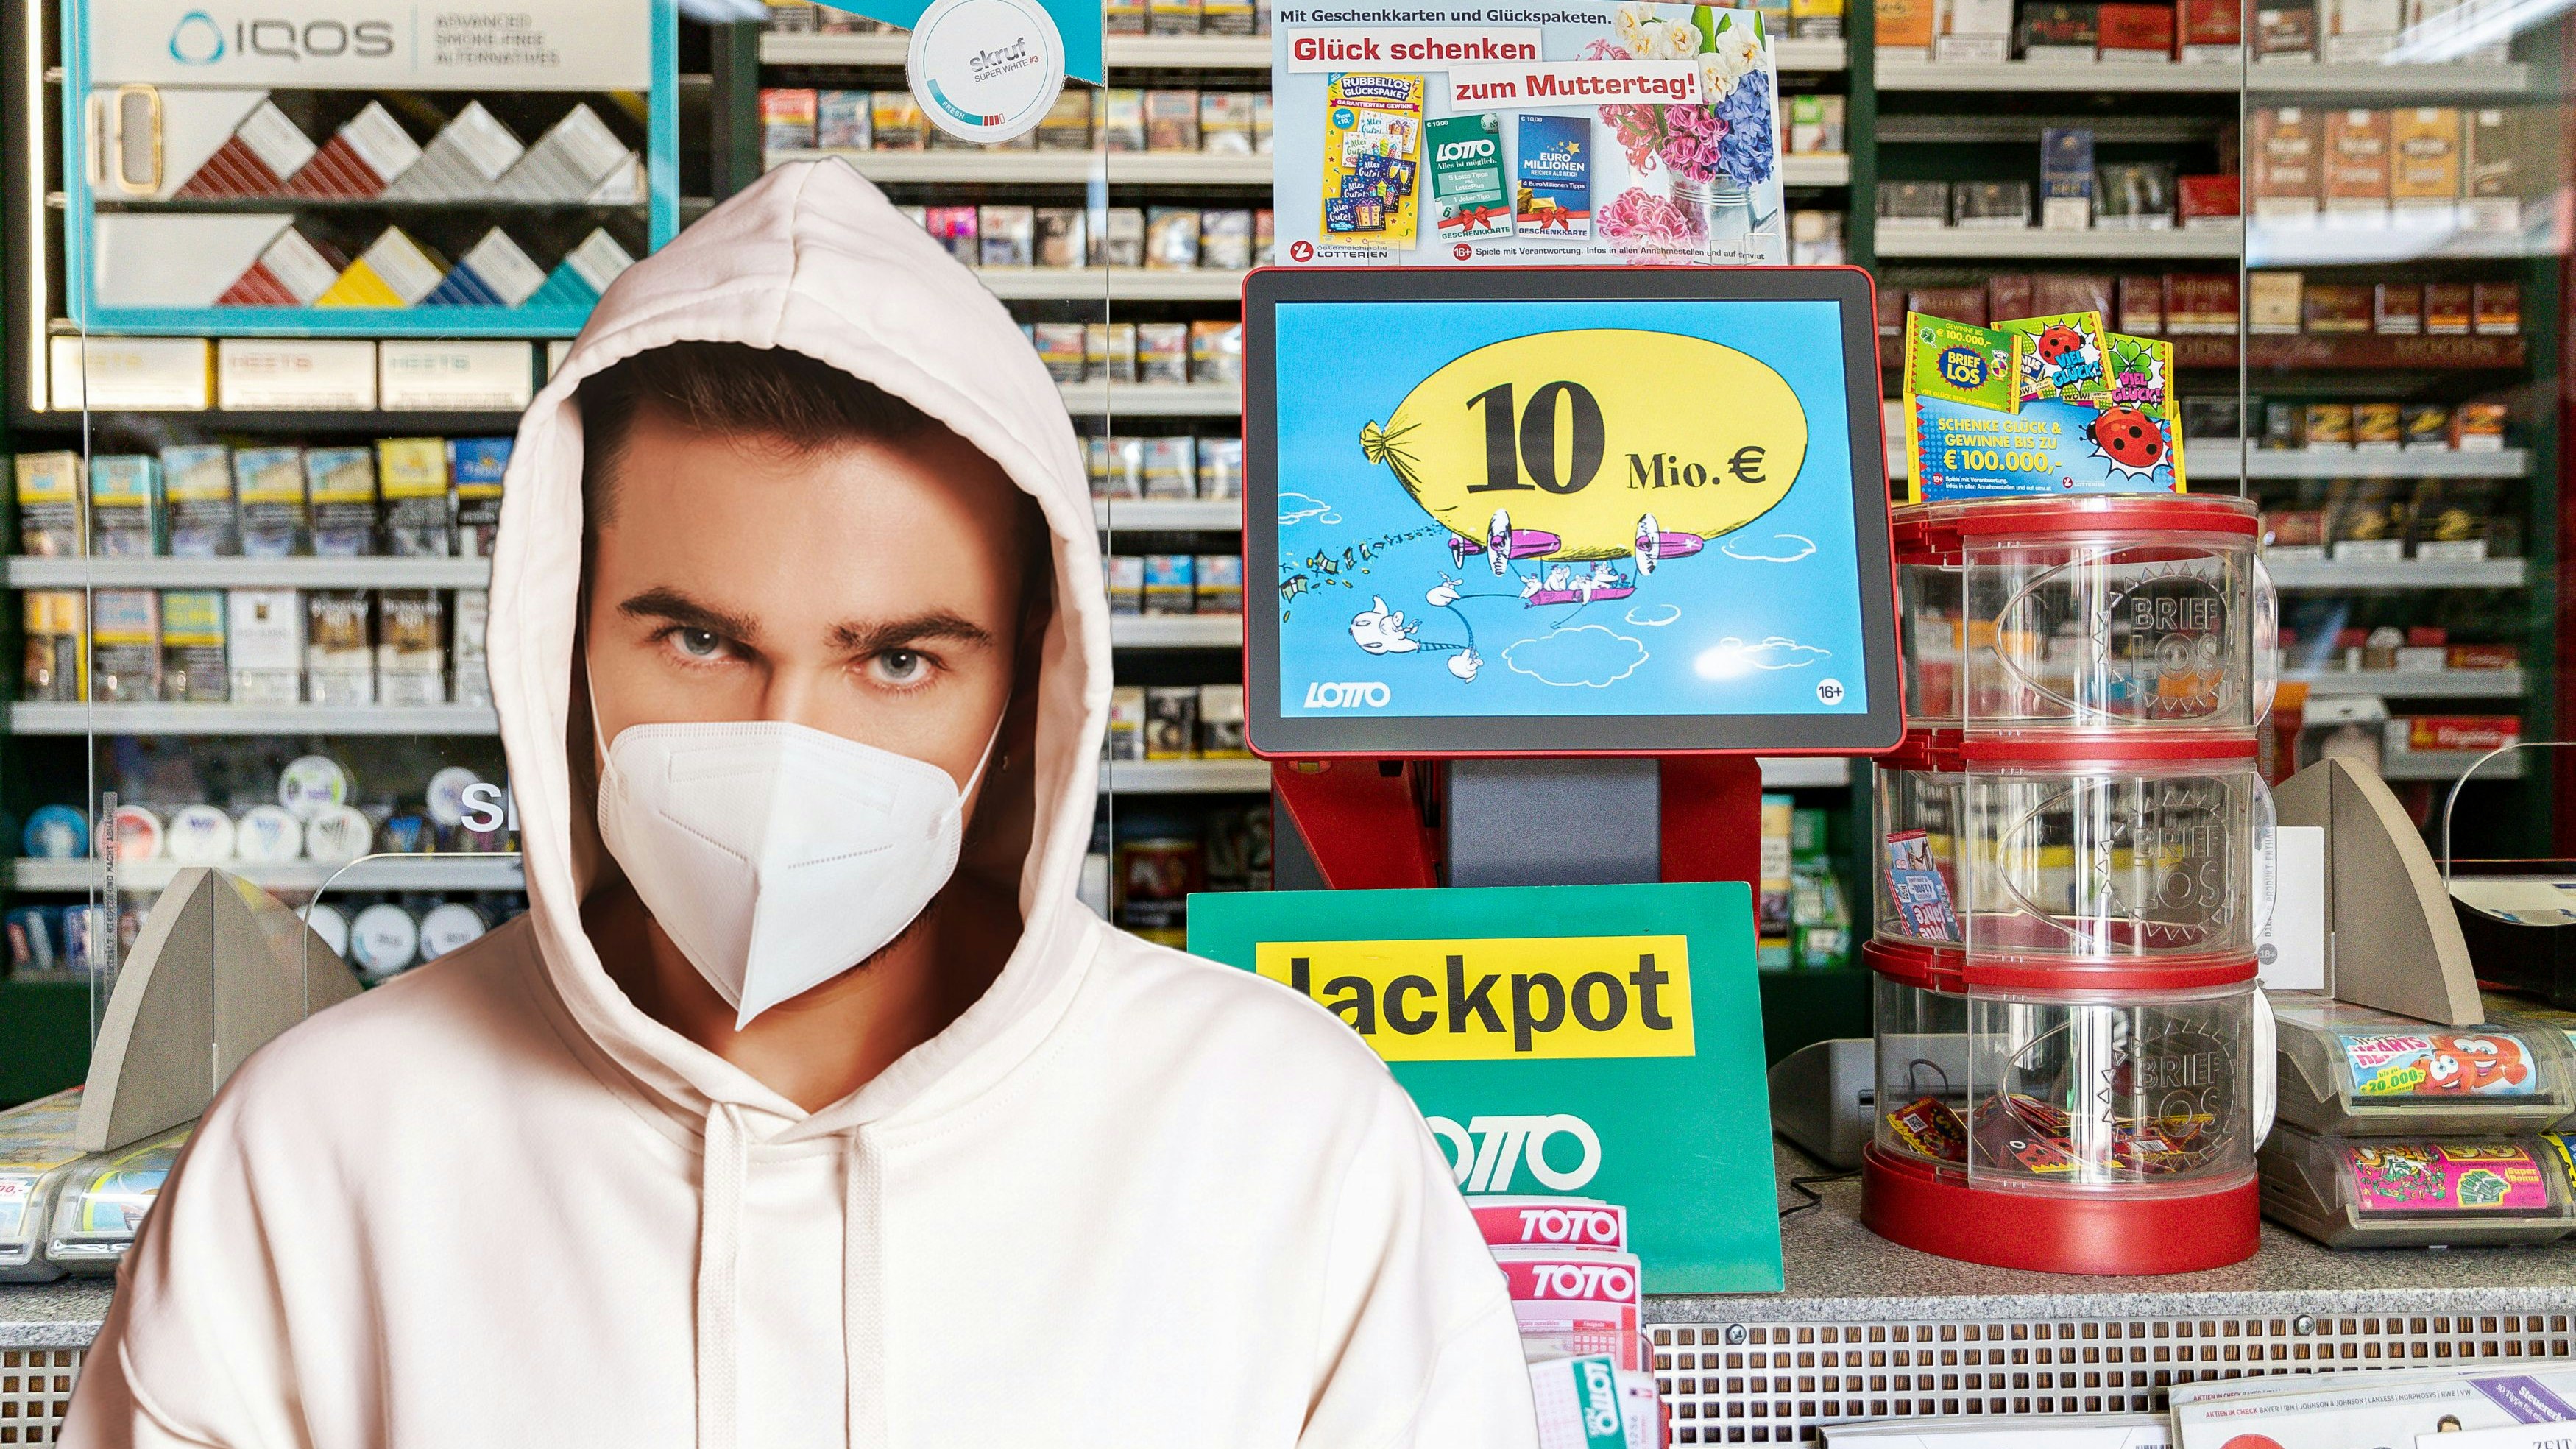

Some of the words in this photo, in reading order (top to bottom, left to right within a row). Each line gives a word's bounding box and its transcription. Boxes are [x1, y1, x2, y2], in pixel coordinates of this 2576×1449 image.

[434, 13, 531, 27] ADVANCED
[1281, 10, 1307, 22] Mit
[1312, 9, 1446, 22] Geschenkkarten
[1451, 9, 1482, 21] und
[1487, 10, 1612, 25] Glückspaketen.
[236, 19, 394, 61] IQOS
[1294, 37, 1381, 60] Glück
[1390, 37, 1536, 60] schenken
[434, 50, 560, 66] ALTERNATIVES
[969, 37, 1026, 73] skruf
[974, 68, 1002, 83] SUPER
[1002, 58, 1029, 74] WHITE
[1030, 55, 1039, 64] #3
[1342, 77, 1411, 91] RUBBELLOS
[1345, 86, 1408, 100] GLÜCKSPAKET
[1456, 81, 1517, 101] zum
[1526, 73, 1696, 101] Muttertag!
[941, 100, 965, 120] FRESH
[1337, 99, 1385, 108] GARANTIERTEM
[1436, 139, 1495, 162] LOTTO
[1540, 152, 1571, 162] EURO
[1364, 161, 1380, 169] Alles
[1437, 161, 1454, 170] Alles
[1466, 158, 1498, 169] möglich.
[1524, 160, 1585, 171] MILLIONEN
[1348, 182, 1364, 190] Alles
[1569, 182, 1585, 190] Tipps
[1459, 194, 1476, 202] Joker
[1329, 212, 1351, 222] Gute!
[1333, 203, 1348, 213] Alles
[1442, 227, 1510, 240] GESCHENKKARTE
[1518, 227, 1587, 236] GESCHENKKARTE
[1454, 248, 1471, 257] 16+
[1476, 247, 1501, 256] Spiele
[1504, 247, 1517, 255] mit
[1519, 247, 1583, 256] Verantwortung.
[1641, 247, 1705, 256] Annahmestellen
[1707, 249, 1722, 258] und
[1945, 323, 1973, 333] GEWINNE
[1936, 328, 1944, 337] €
[1946, 329, 1992, 347] 100.000,-
[1947, 351, 1981, 368] BRIEF
[2054, 350, 2084, 369] VIEL
[1947, 363, 1981, 385] LOS
[2052, 361, 2103, 387] GLÜCK!
[2119, 372, 2148, 387] VIEL
[2064, 392, 2090, 400] WOW!
[2112, 385, 2163, 403] GLÜCK!
[1938, 417, 1999, 432] SCHENKE
[2003, 417, 2049, 434] GLÜCK
[2051, 422, 2062, 434] &
[1465, 380, 1606, 495] 10
[1945, 434, 2011, 447] GEWINNE
[2014, 436, 2035, 448] BIS
[2039, 436, 2057, 449] ZU
[1625, 453, 1721, 489] Mio.
[1727, 446, 1766, 484] €
[1944, 449, 1958, 470] €
[1961, 450, 2062, 475] 100.000,-
[2131, 597, 2218, 631] BRIEF
[2131, 633, 2220, 681] LOS
[1303, 681, 1392, 709] LOTTO
[1818, 685, 1844, 700] 16+
[2134, 826, 2219, 859] BRIEF
[2134, 858, 2221, 910] LOS
[2135, 1051, 2220, 1088] BRIEF
[1519, 1208, 1618, 1242] TOTO
[1532, 1264, 1634, 1300] TOTO
[1583, 1362, 1619, 1435] LOTTO
[2193, 1393, 2215, 1402] AKTIEN
[2205, 1410, 2229, 1419] AKTIEN
[2236, 1407, 2257, 1416] CHECK
[2259, 1406, 2279, 1414] BAYER
[2283, 1403, 2295, 1412] IBM
[2299, 1400, 2329, 1410] JOHNSON
[2336, 1398, 2364, 1407] JOHNSON
[2368, 1395, 2394, 1405] LANXESS
[2399, 1392, 2437, 1401] MORPHOSYS
[2441, 1389, 2455, 1398] RWE
[2460, 1389, 2471, 1397] VW
[2506, 1390, 2524, 1409] Tipps
[2522, 1402, 2533, 1417] für
